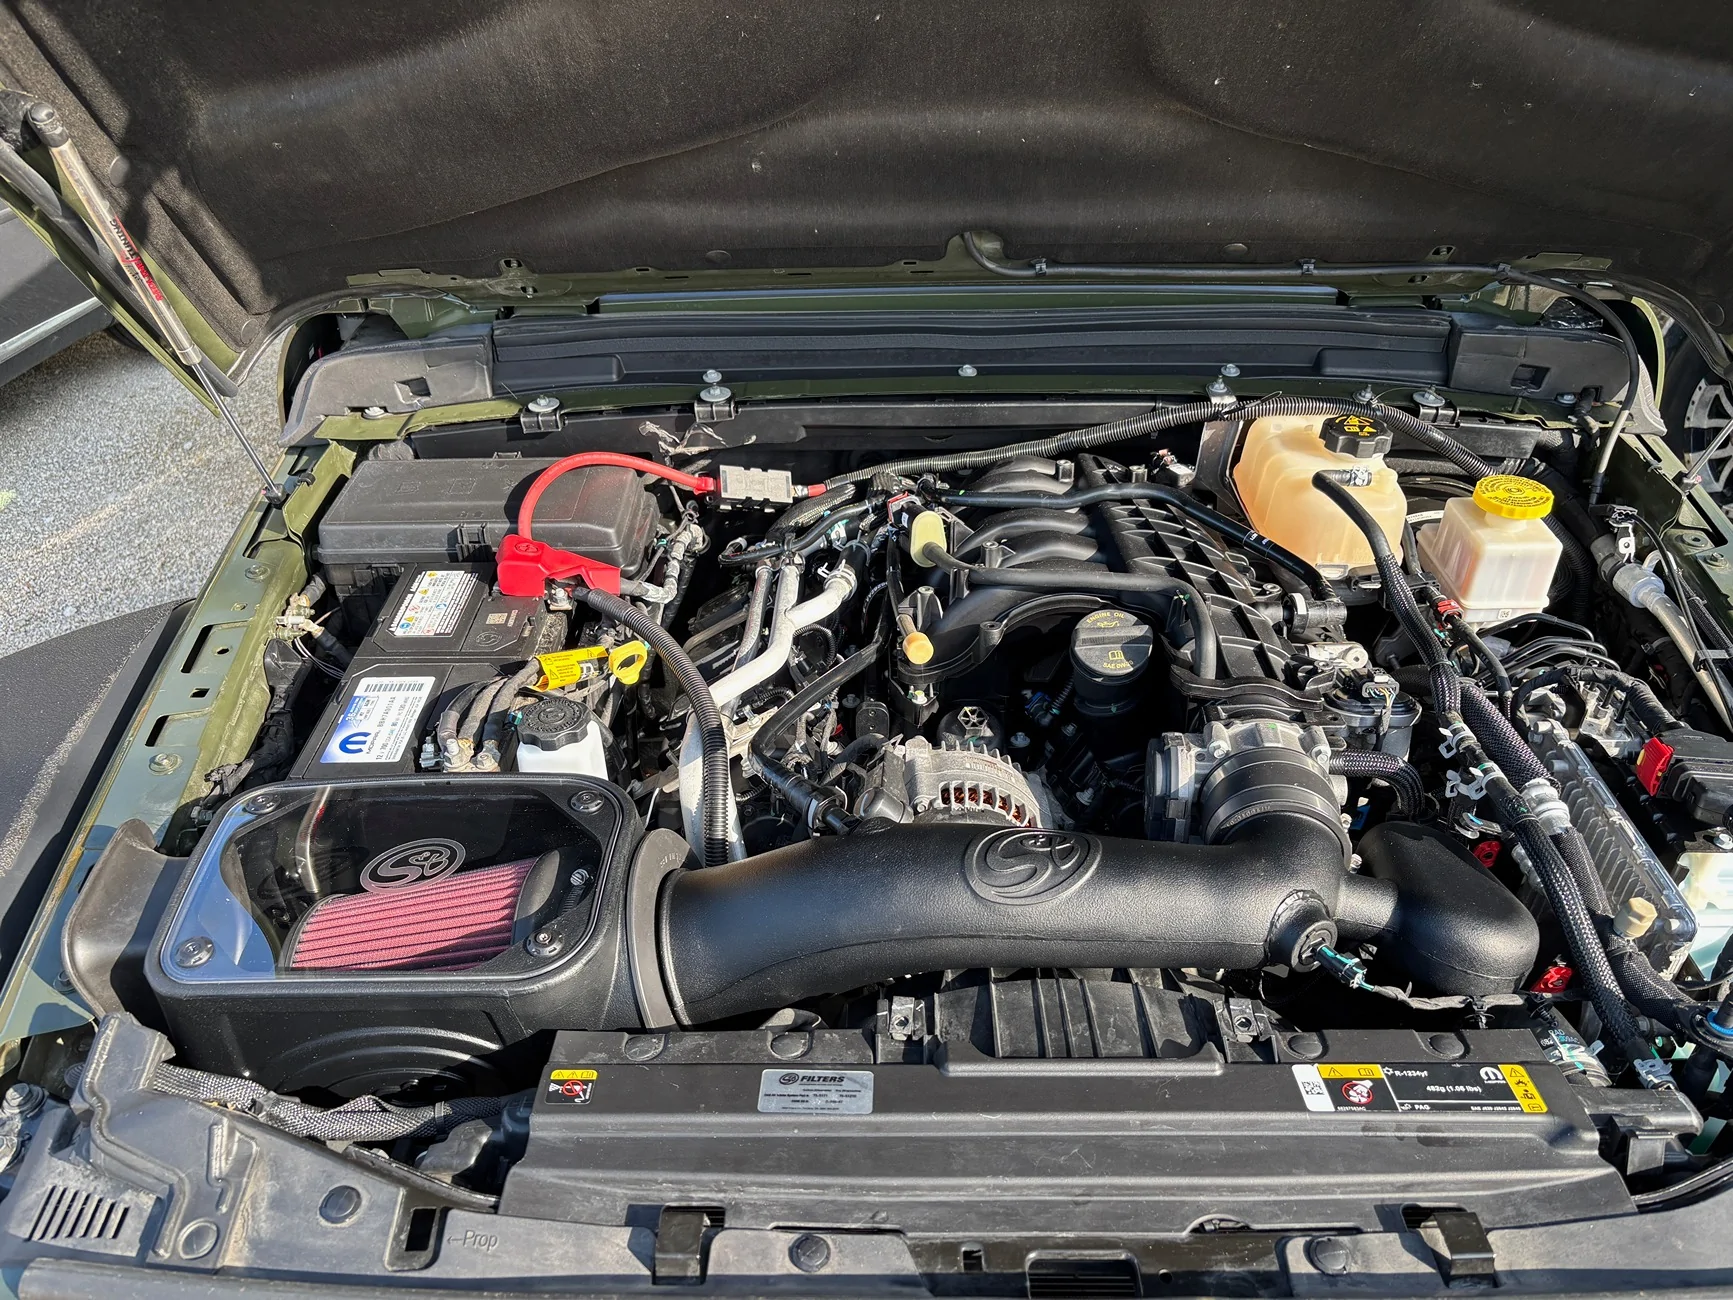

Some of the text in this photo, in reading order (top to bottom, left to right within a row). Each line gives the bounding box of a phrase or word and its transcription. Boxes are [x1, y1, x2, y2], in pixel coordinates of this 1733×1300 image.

[110, 219, 138, 259] TUNING
[1086, 611, 1125, 624] ENGINE OIL
[800, 1075, 845, 1083] FILTERS
[463, 1229, 499, 1252] Prop
